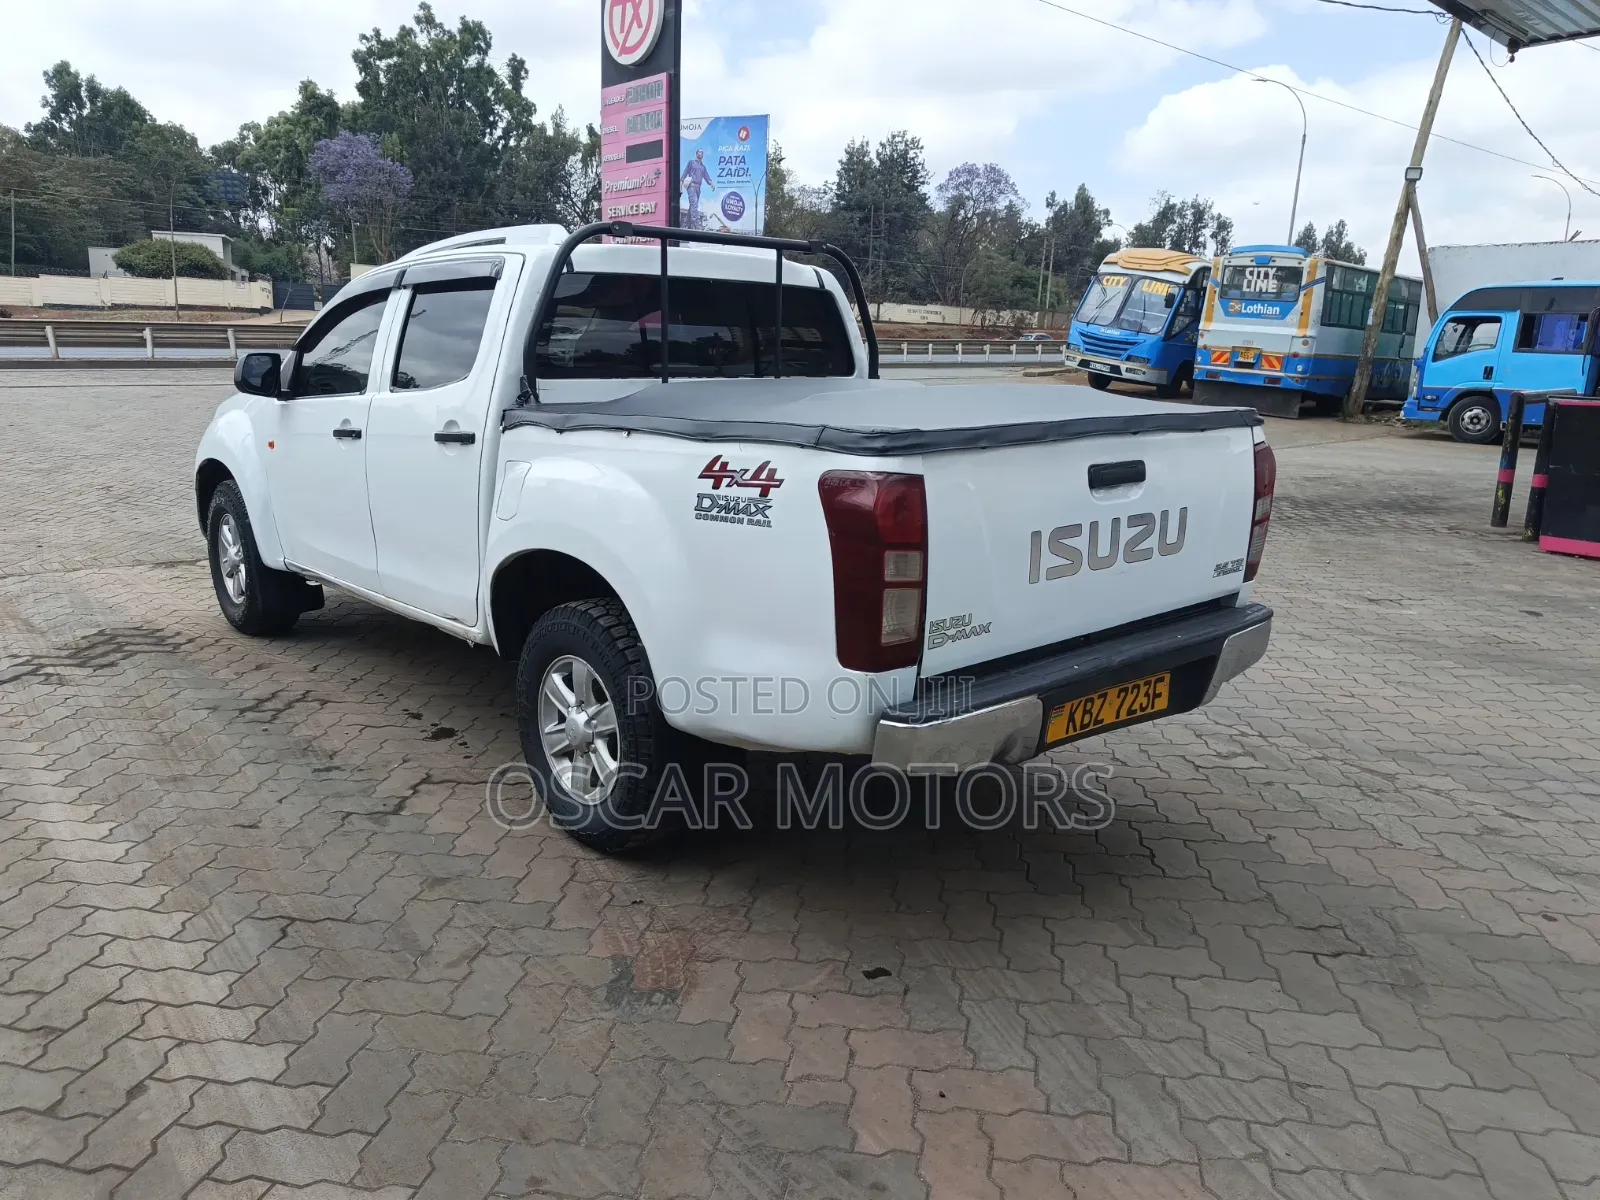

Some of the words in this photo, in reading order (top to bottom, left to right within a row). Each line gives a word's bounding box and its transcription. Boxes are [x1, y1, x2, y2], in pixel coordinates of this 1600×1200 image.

[603, 126, 618, 135] DIESEL
[718, 155, 746, 166] PATA
[607, 203, 639, 218] SERVICE
[641, 201, 658, 214] BAY
[1102, 275, 1128, 287] CITY
[1245, 268, 1277, 280] CITY
[1242, 280, 1277, 292] LINE
[1241, 303, 1280, 315] Lothian
[697, 454, 785, 498] 4x4
[694, 492, 773, 519] D-MAX
[721, 495, 747, 503] ISUZU
[694, 512, 745, 525] COMMON
[746, 518, 773, 528] RAIL
[1028, 506, 1188, 585] ISUZU
[929, 613, 972, 635] ISUZU
[928, 621, 993, 650] D-MAX
[1065, 691, 1109, 736] KBZ
[1115, 675, 1166, 720] 723F
